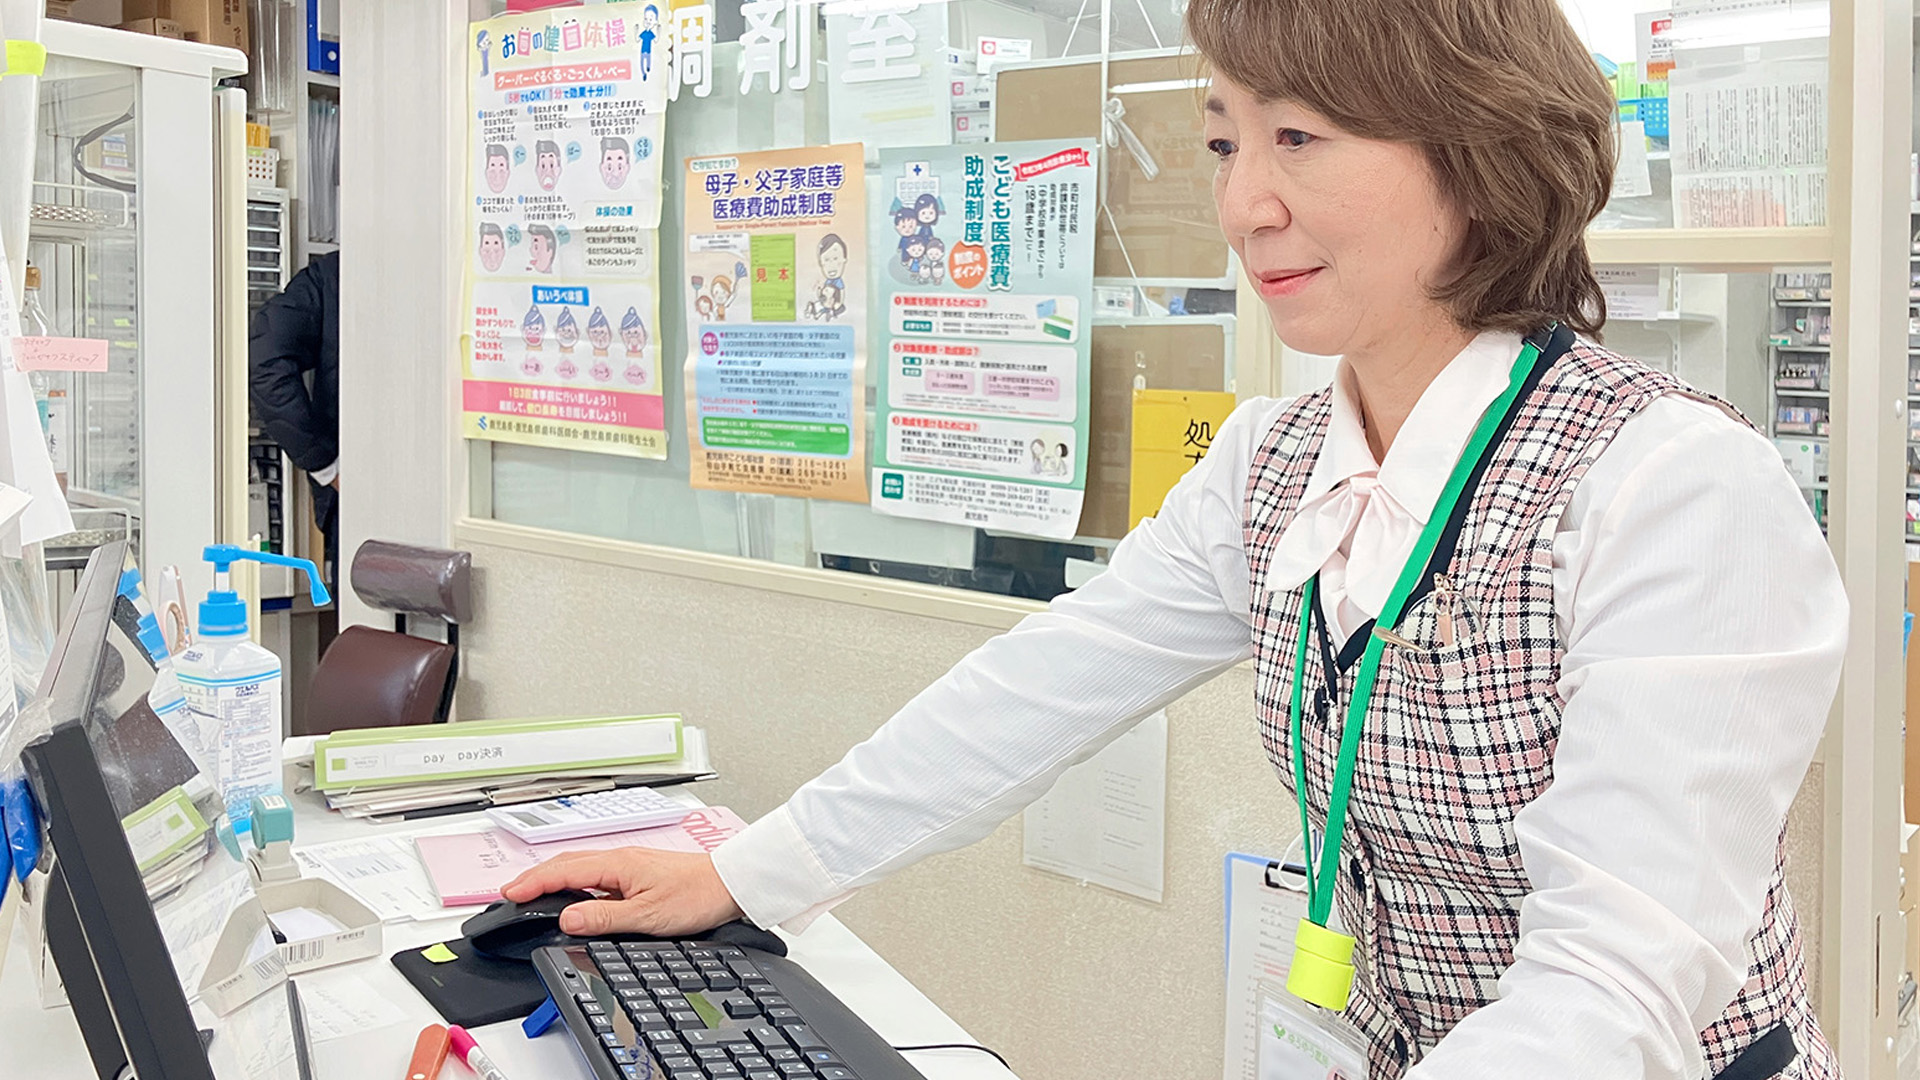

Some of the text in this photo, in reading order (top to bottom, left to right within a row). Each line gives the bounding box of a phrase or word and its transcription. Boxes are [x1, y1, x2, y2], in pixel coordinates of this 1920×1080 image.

[706, 165, 843, 195] 母子・父子家庭等
[713, 192, 833, 219] 医療費助成制度
[964, 155, 984, 242] 助成制度
[990, 155, 1011, 288] こども医療費
[778, 268, 790, 281] 本
[424, 747, 502, 764] pay pay決済
